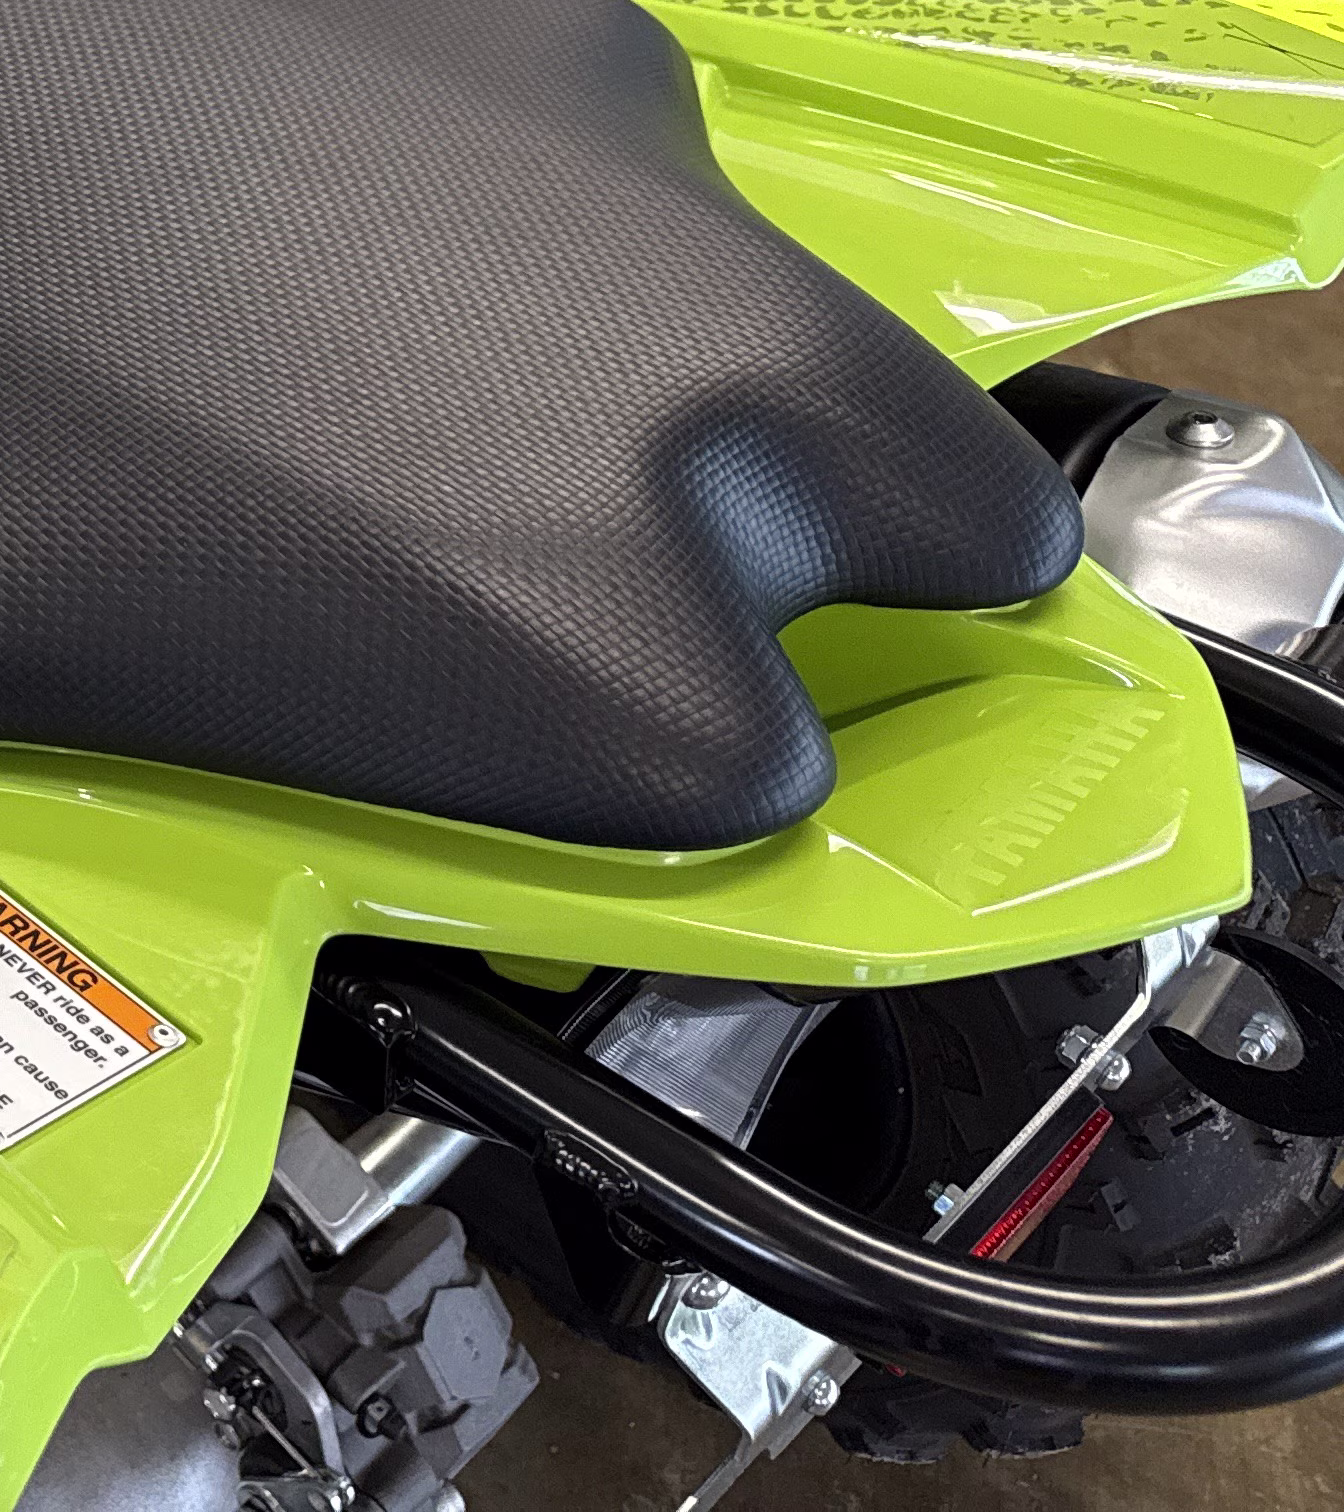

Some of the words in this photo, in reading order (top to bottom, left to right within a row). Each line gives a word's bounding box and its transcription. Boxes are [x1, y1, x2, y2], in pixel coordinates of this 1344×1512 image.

[10, 990, 105, 1069] passenger.
[53, 993, 91, 1026] ride
[90, 1025, 114, 1046] as
[114, 1043, 130, 1057] a
[14, 1054, 69, 1101] cause
